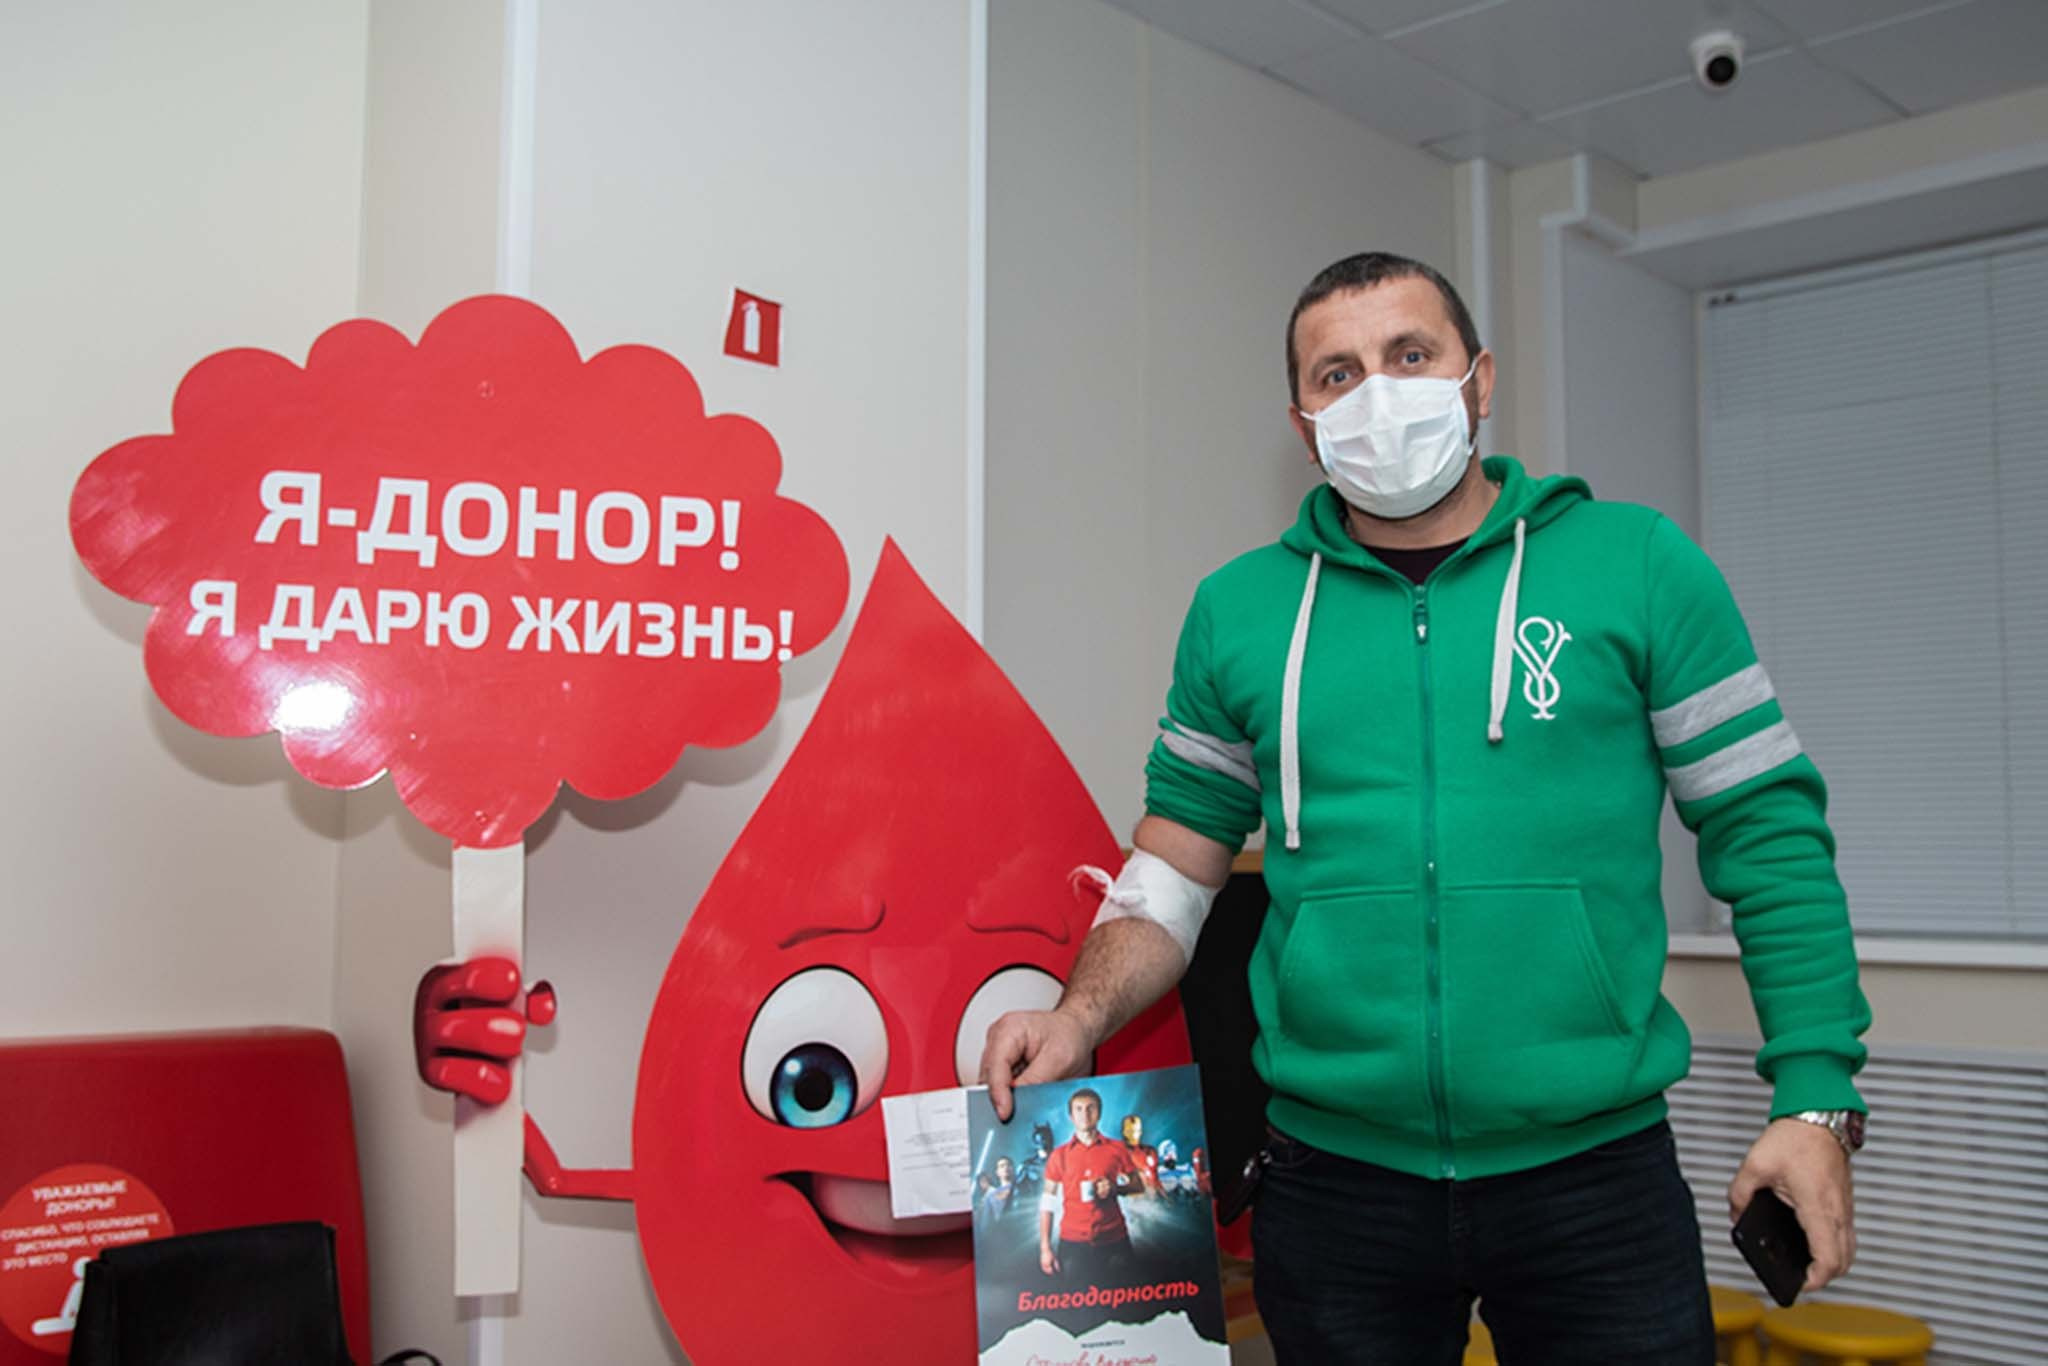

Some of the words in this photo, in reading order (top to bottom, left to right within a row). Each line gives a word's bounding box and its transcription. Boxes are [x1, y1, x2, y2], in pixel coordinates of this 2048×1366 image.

[254, 469, 741, 570] Я-ДОНОР!
[186, 580, 237, 638] Я
[258, 584, 490, 653] ДАРЮ
[507, 596, 794, 662] ЖИЗНЬ!
[32, 1180, 127, 1202] УВАЖАЕМЫЕ
[45, 1196, 116, 1217] ДОНОРЫ!
[2, 1257, 26, 1271] ЭТО
[28, 1252, 68, 1267] МЕСТО
[1018, 1280, 1200, 1312] Благодарность
